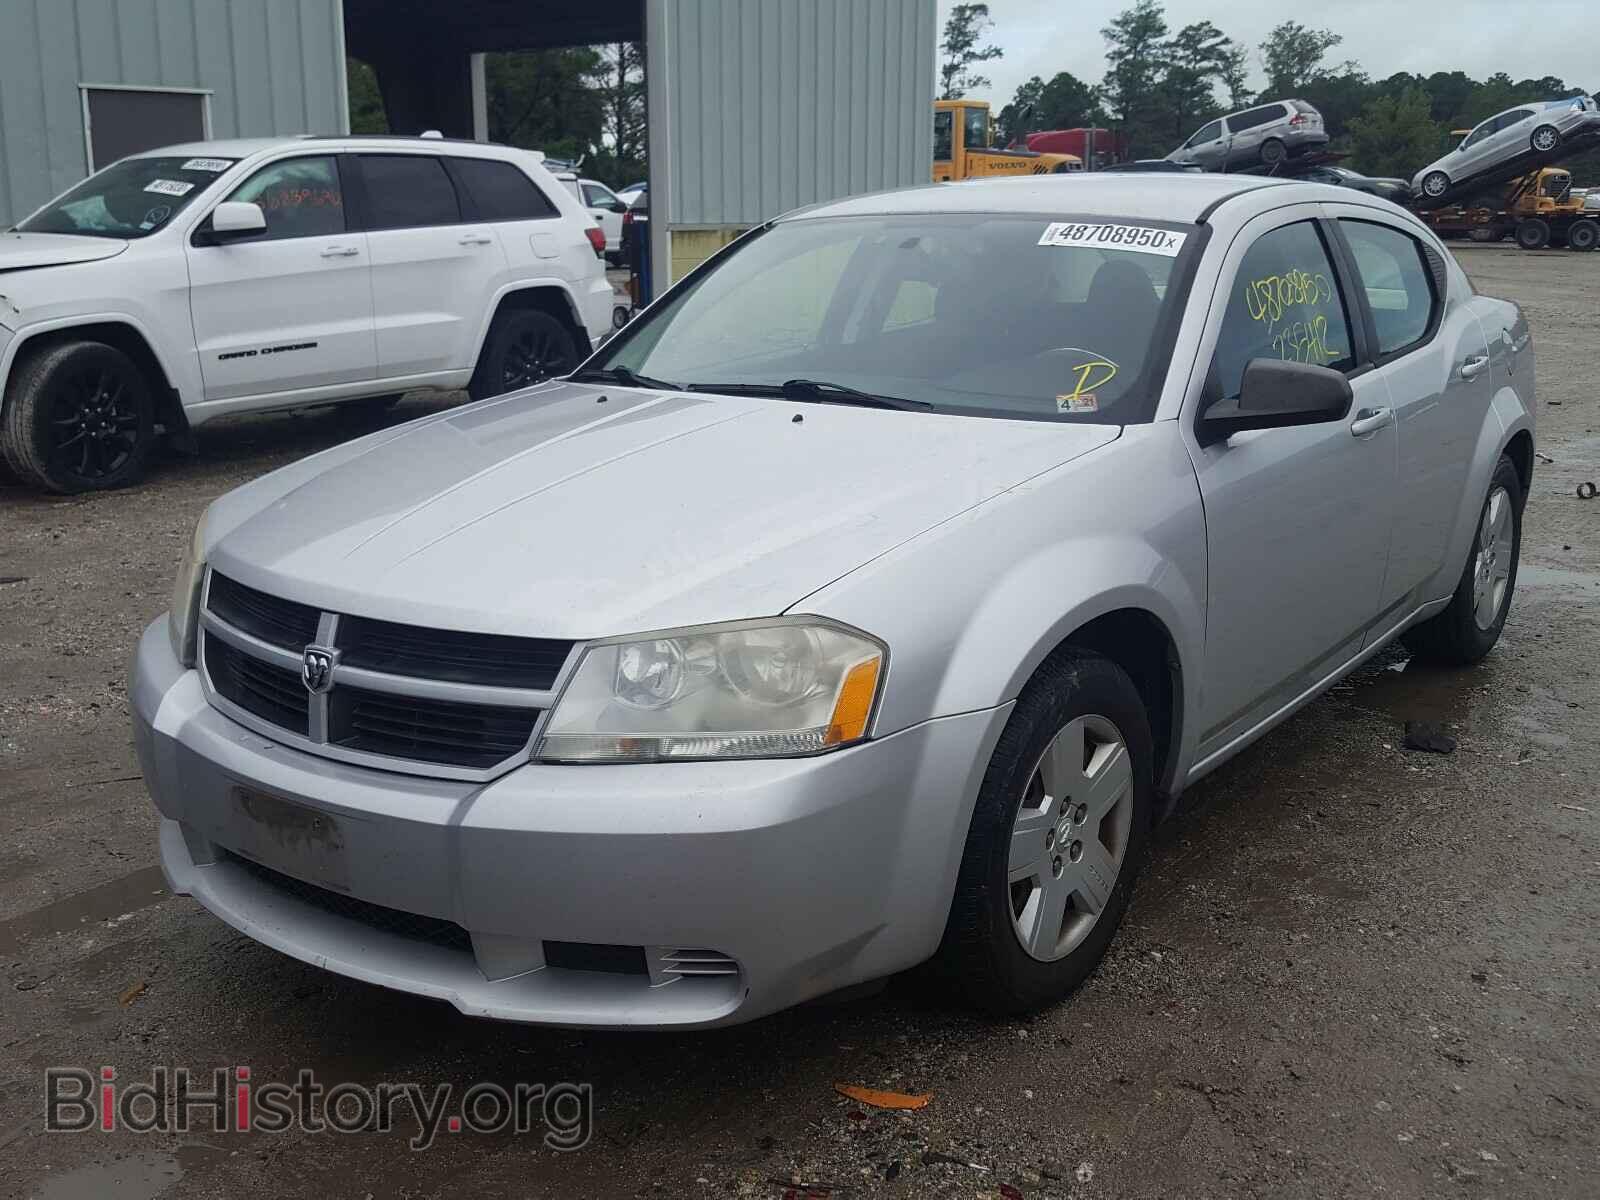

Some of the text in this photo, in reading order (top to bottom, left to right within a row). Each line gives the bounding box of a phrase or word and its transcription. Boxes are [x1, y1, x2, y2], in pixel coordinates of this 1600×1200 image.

[990, 161, 1026, 169] VOLVO
[1059, 224, 1166, 248] 48708950
[218, 350, 258, 360] GRAND
[1060, 399, 1072, 411] 4
